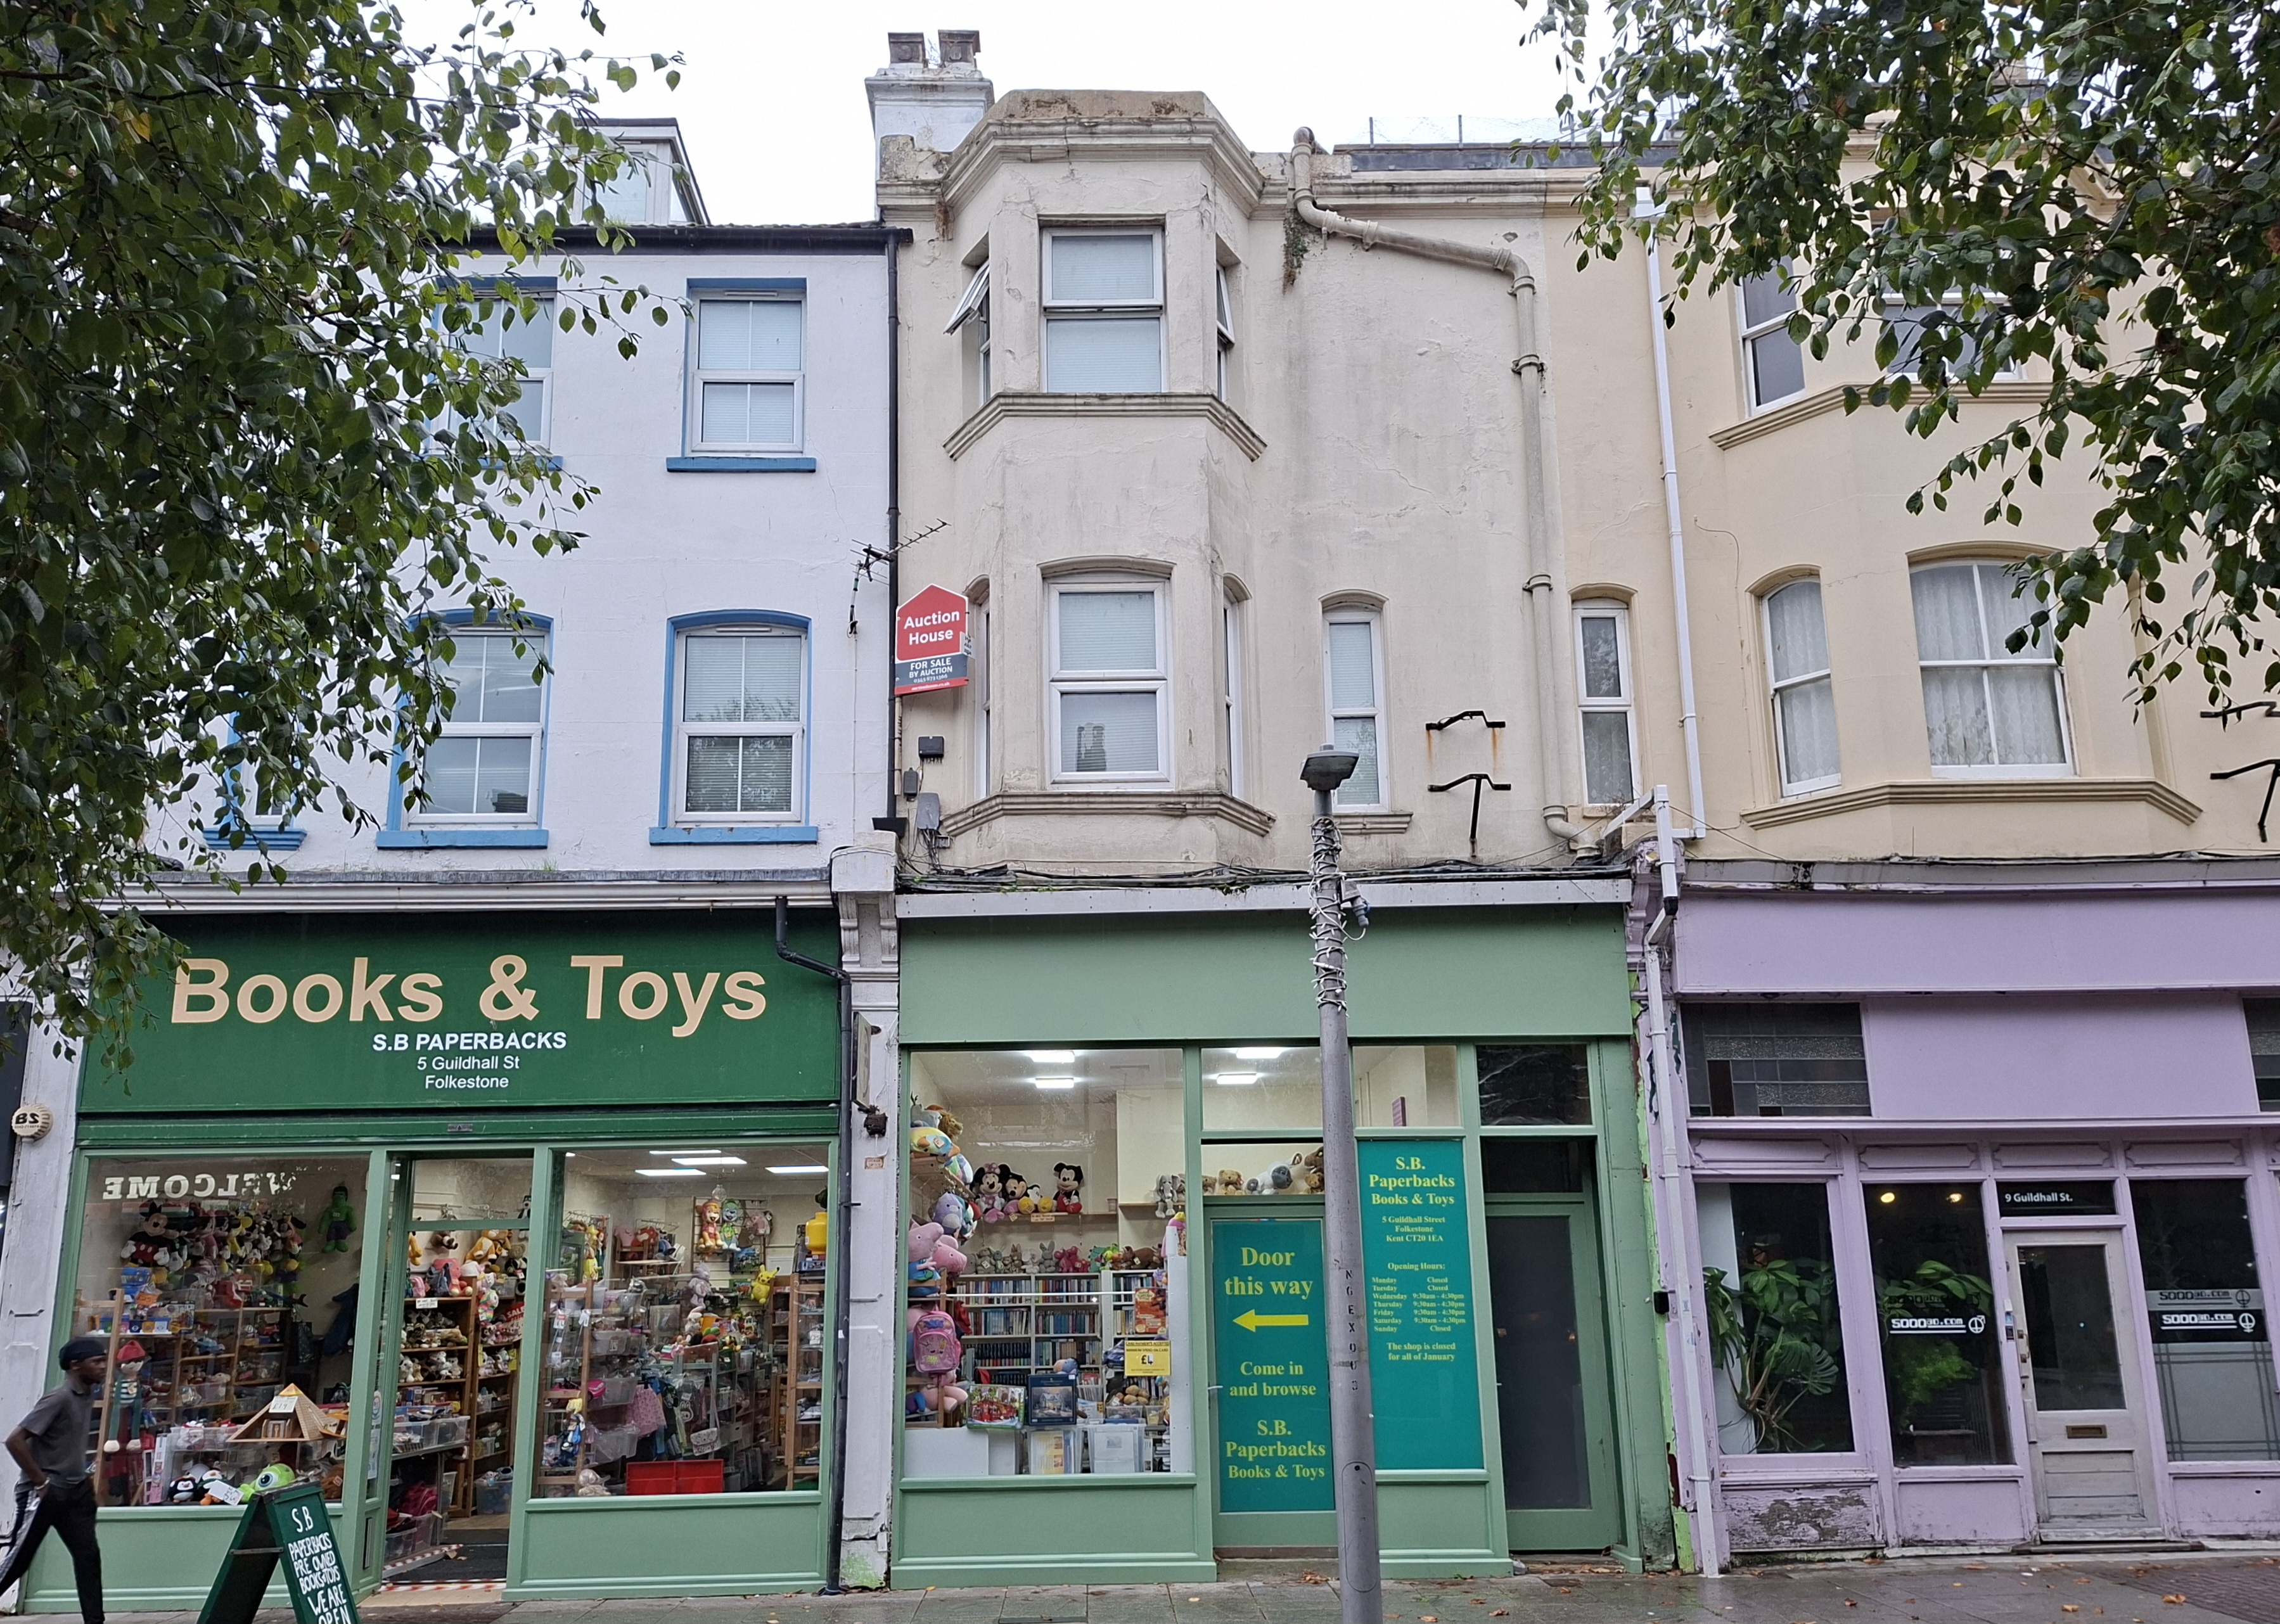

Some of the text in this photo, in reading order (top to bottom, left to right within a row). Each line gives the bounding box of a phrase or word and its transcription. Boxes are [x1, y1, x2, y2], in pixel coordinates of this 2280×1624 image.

[904, 611, 959, 629] Auction
[909, 630, 953, 646] House
[910, 657, 951, 670] FOR SALE
[909, 666, 952, 679] BY AUCTION
[171, 954, 765, 1037] Books & Toys
[373, 1032, 567, 1051] S.B PAPERBACKS
[417, 1056, 520, 1070] 5 Guildhall St
[425, 1075, 509, 1089] Folkestone
[15, 1113, 39, 1124] BS
[1396, 1156, 1425, 1170] S.B.
[1369, 1174, 1455, 1191] Paperbacks
[1371, 1193, 1454, 1207] Books & Toys
[2005, 1192, 2073, 1202] 9 Guildhall St.
[1240, 1247, 1295, 1266] Door
[1388, 1262, 1419, 1271] Opening
[1224, 1276, 1314, 1300] this way
[1404, 1343, 1422, 1352] shop
[1141, 1355, 1153, 1365] £4
[1423, 1353, 1455, 1362] January
[1240, 1361, 1303, 1375] Come in
[1229, 1383, 1316, 1397] and browse
[1257, 1420, 1291, 1436] S.B.
[1226, 1441, 1326, 1461] Paperbacks
[1228, 1464, 1325, 1481] Books & Toys
[291, 1506, 314, 1533] S.B
[288, 1532, 333, 1562] PAPERBACKS
[293, 1550, 336, 1578] PRE OWNED
[307, 1583, 347, 1616] WE ARE
